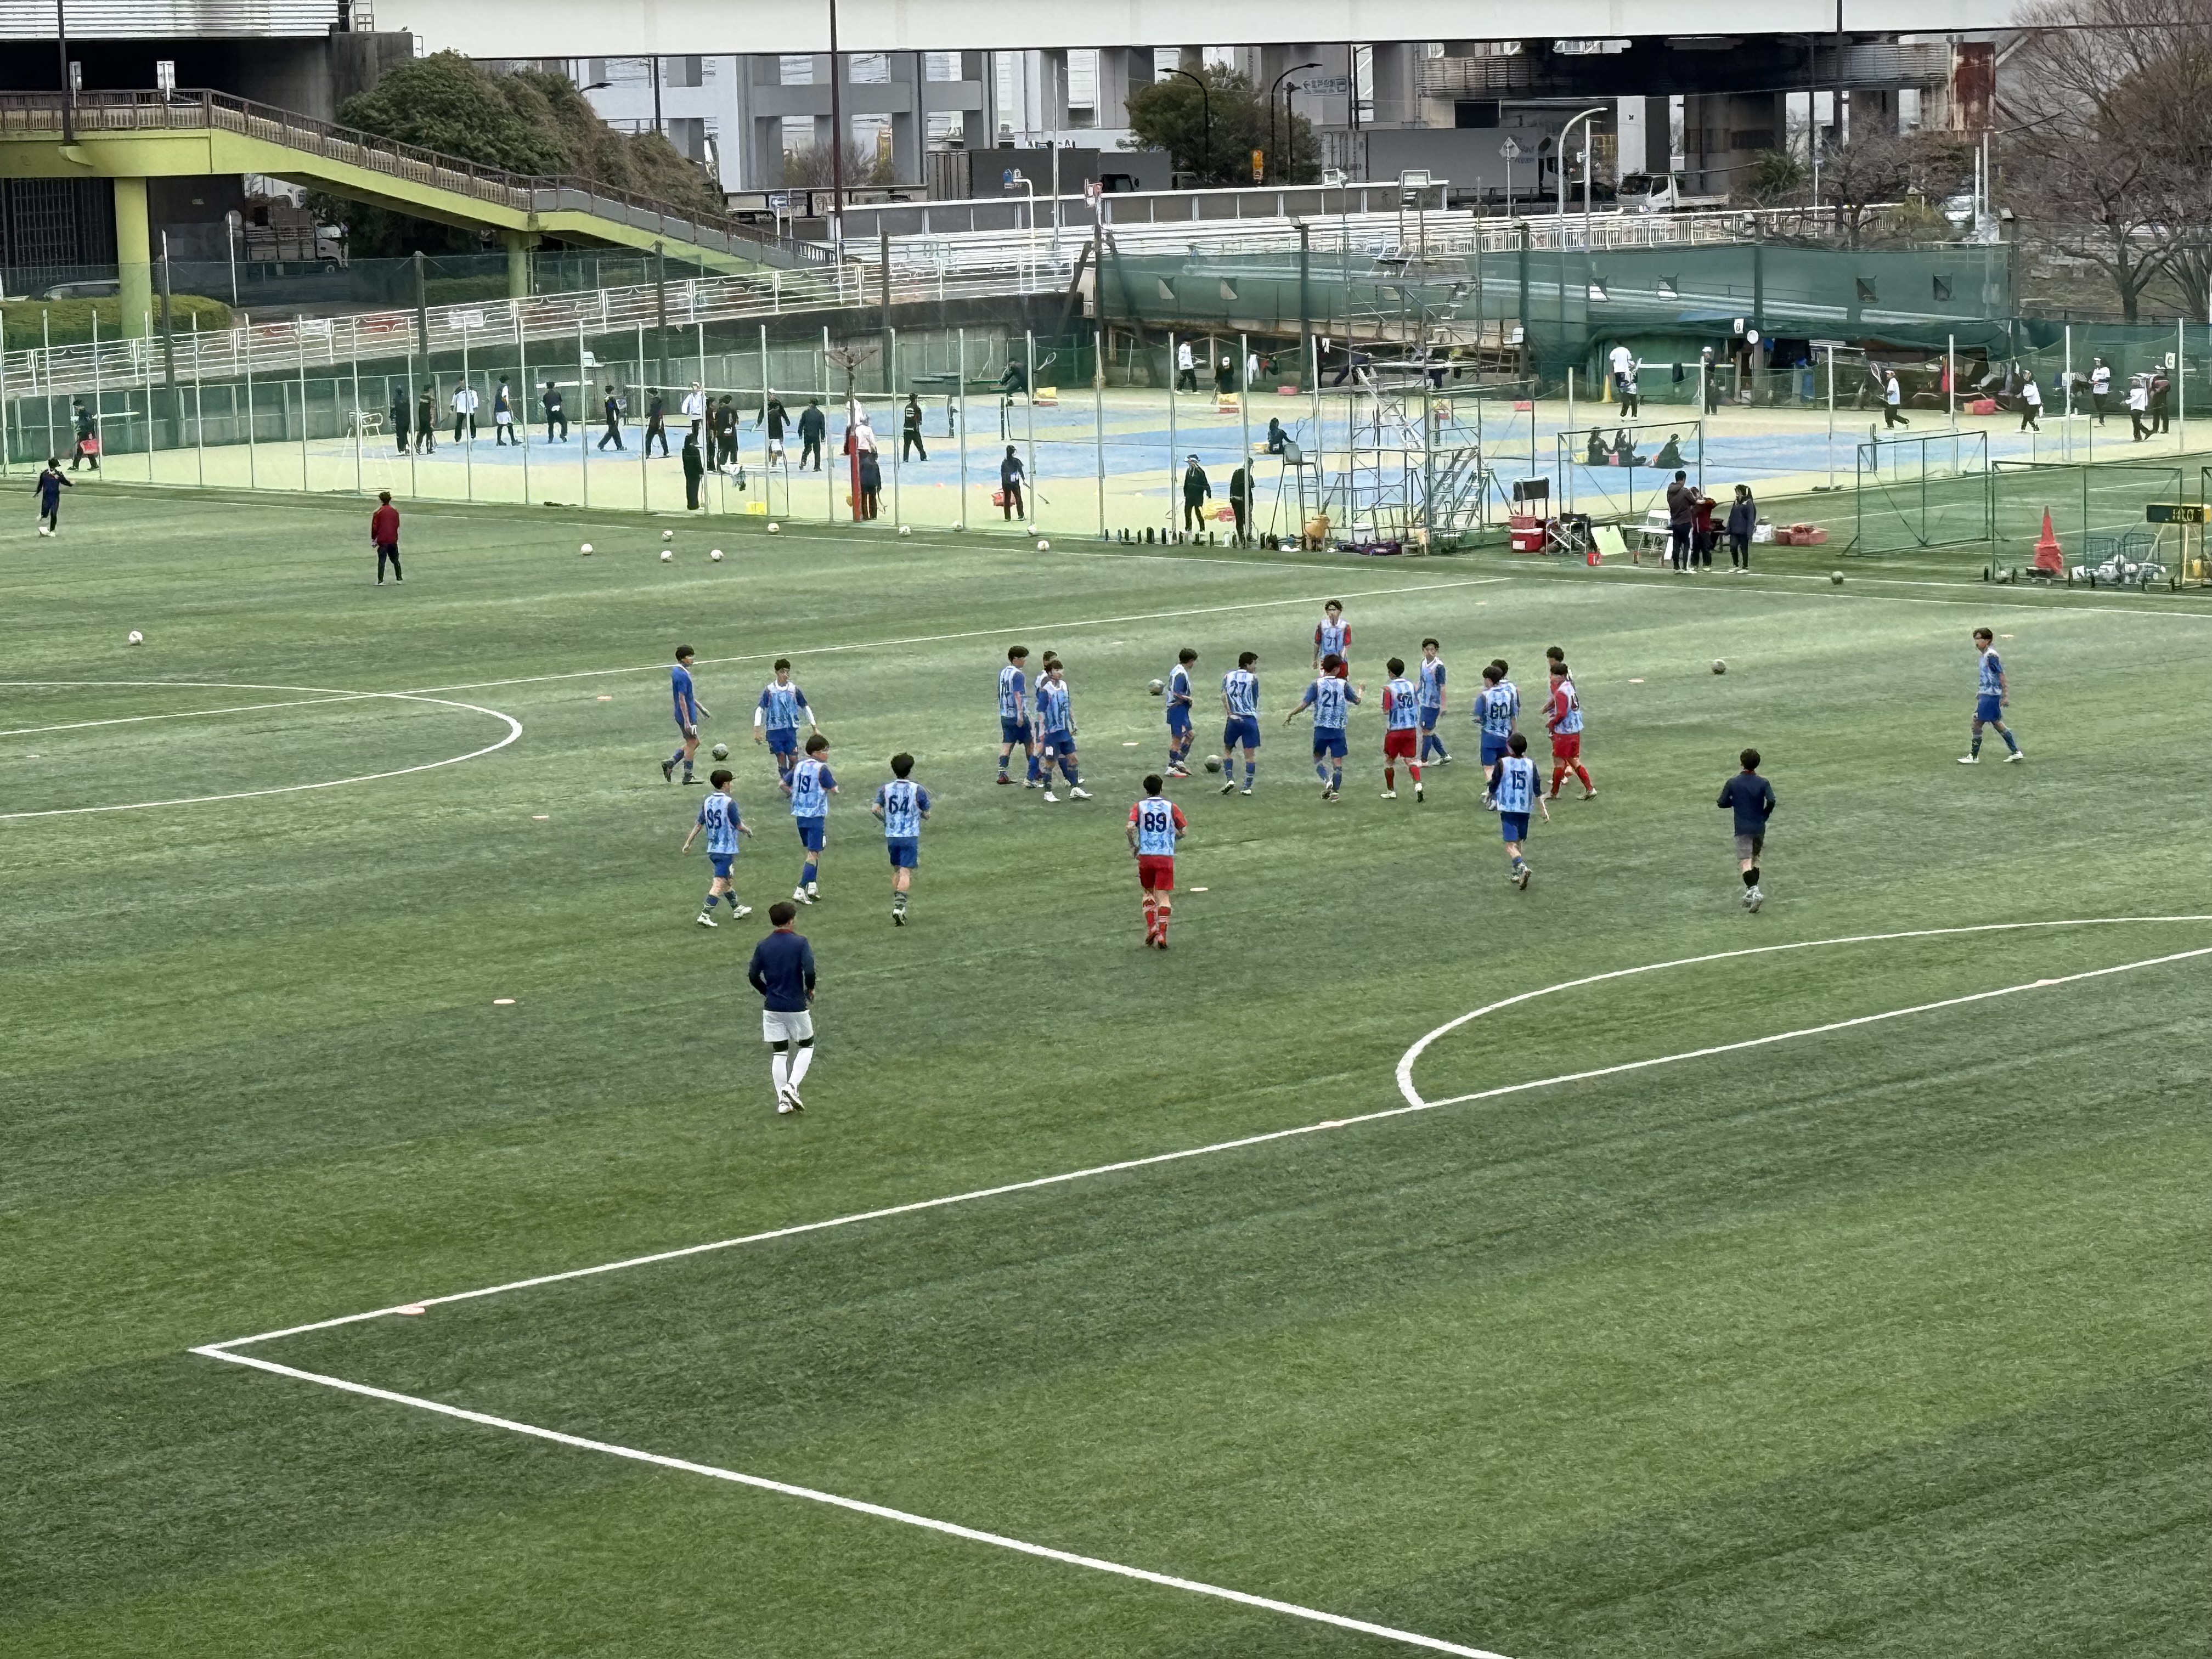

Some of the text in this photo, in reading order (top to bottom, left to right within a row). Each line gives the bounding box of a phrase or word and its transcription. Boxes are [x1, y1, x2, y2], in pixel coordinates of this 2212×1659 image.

[1229, 680, 1248, 697] 27
[1322, 689, 1339, 708] 21
[797, 773, 811, 794] 19
[1510, 770, 1527, 790] 15
[888, 795, 910, 815] 64
[1144, 811, 1167, 833] 89
